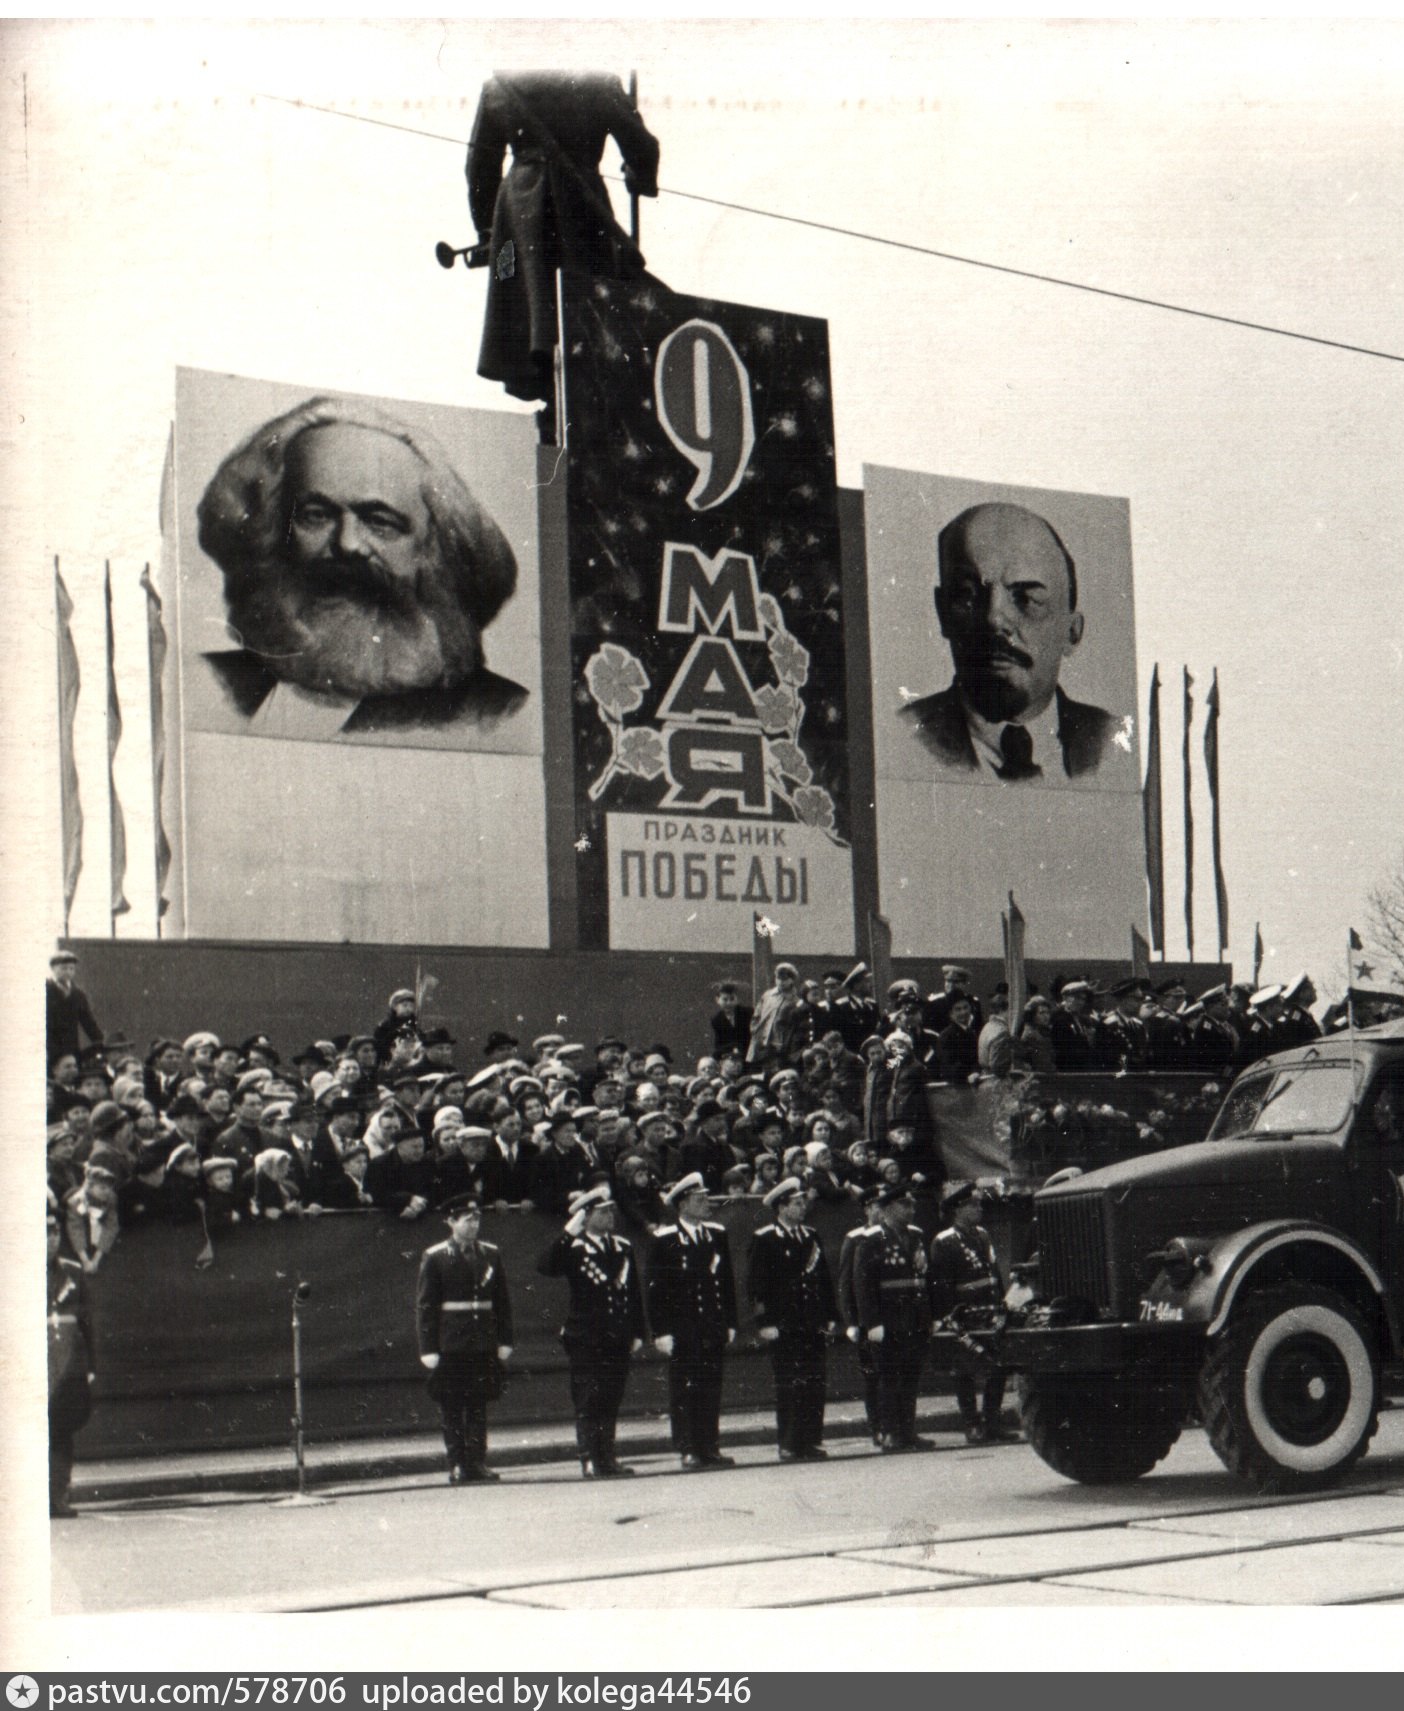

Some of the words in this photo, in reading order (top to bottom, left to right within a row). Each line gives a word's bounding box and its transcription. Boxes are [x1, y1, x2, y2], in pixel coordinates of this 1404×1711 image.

[654, 318, 756, 511] 9
[655, 541, 774, 814] МАЯ
[621, 850, 808, 905] ПОБЕДЫ
[644, 820, 787, 848] ПРАЗДНИК
